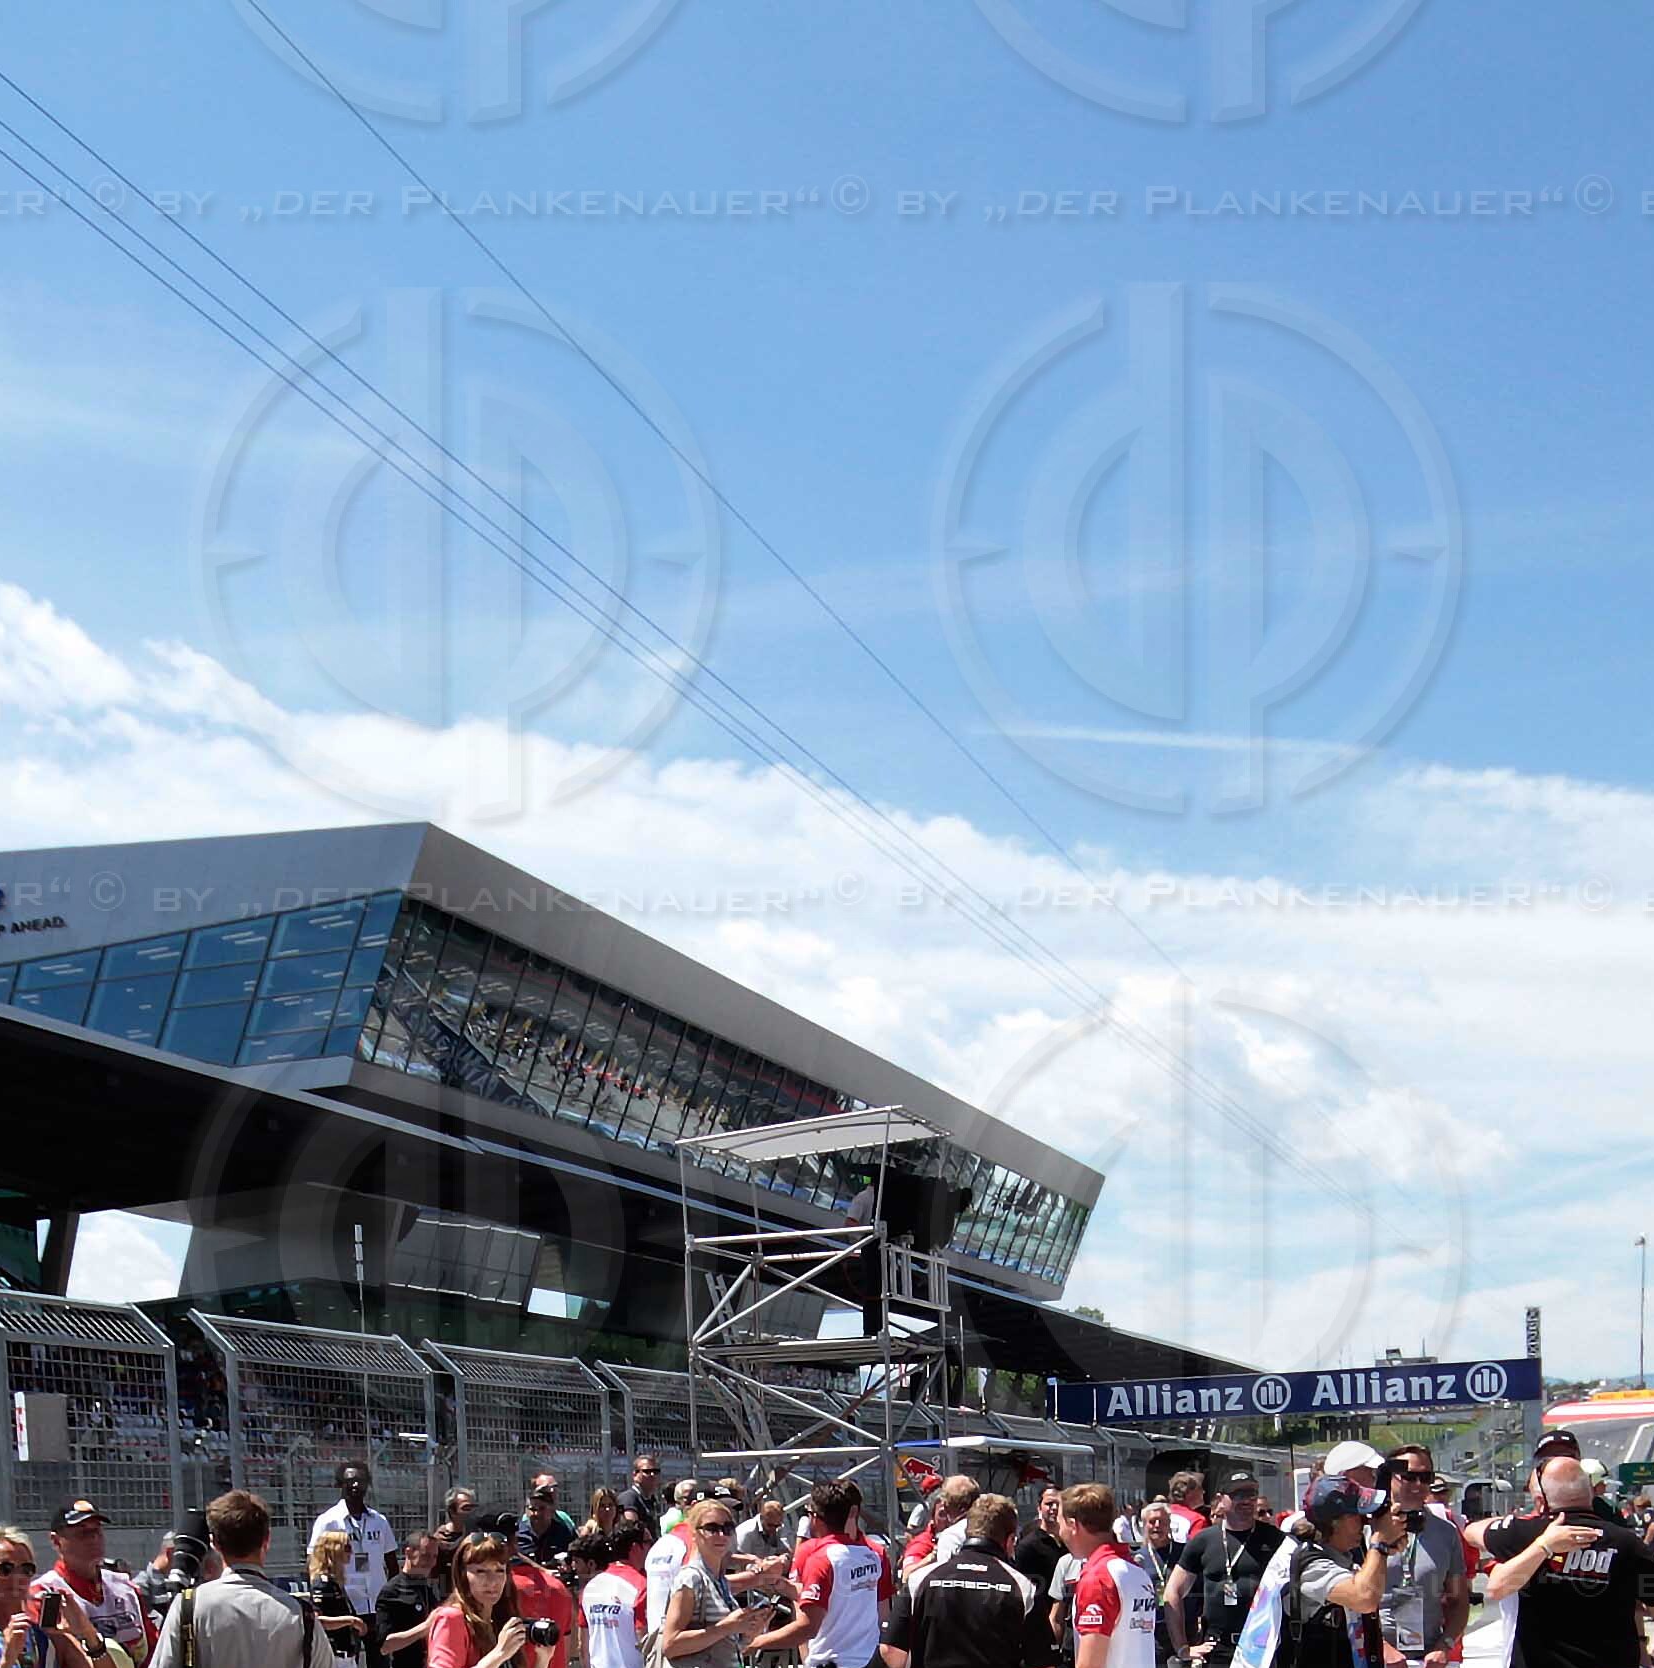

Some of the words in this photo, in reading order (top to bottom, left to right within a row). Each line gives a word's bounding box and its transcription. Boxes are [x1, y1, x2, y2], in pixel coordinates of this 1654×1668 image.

[1106, 1383, 1244, 1418] Allianz
[1311, 1370, 1457, 1407] Allianz
[930, 1579, 1012, 1593] PORSCHE
